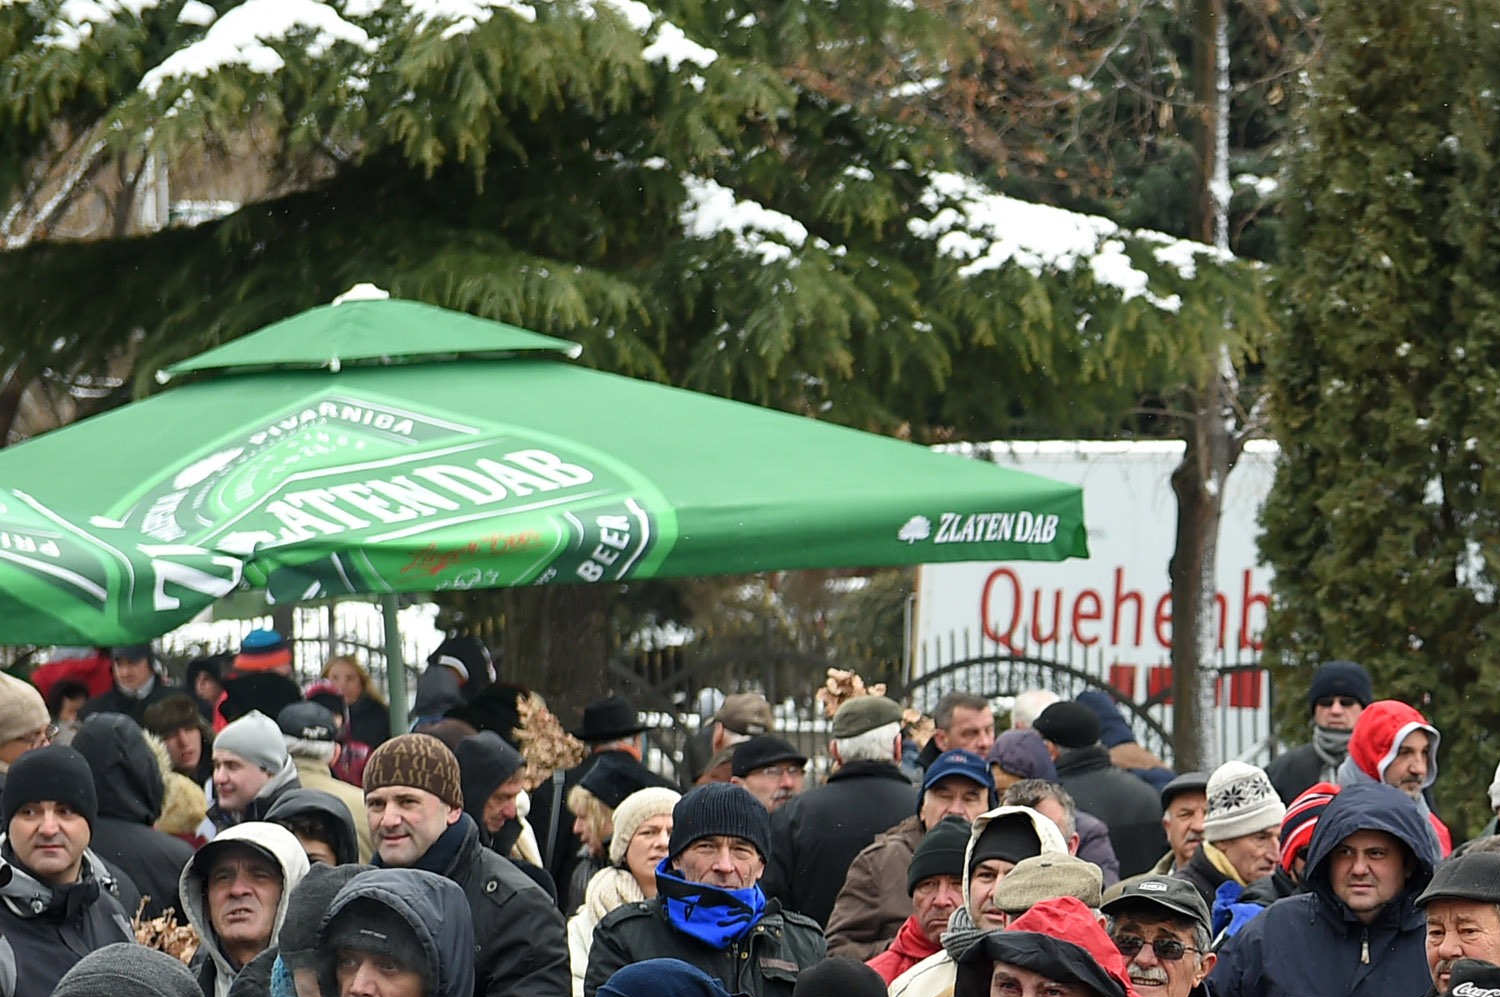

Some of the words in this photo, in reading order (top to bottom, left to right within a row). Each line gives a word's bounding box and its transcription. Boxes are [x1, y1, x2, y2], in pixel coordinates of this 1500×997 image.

[412, 449, 594, 505] DAB
[575, 513, 631, 583] BEER
[934, 512, 1012, 544] ZLATEN
[1014, 511, 1059, 544] DAB
